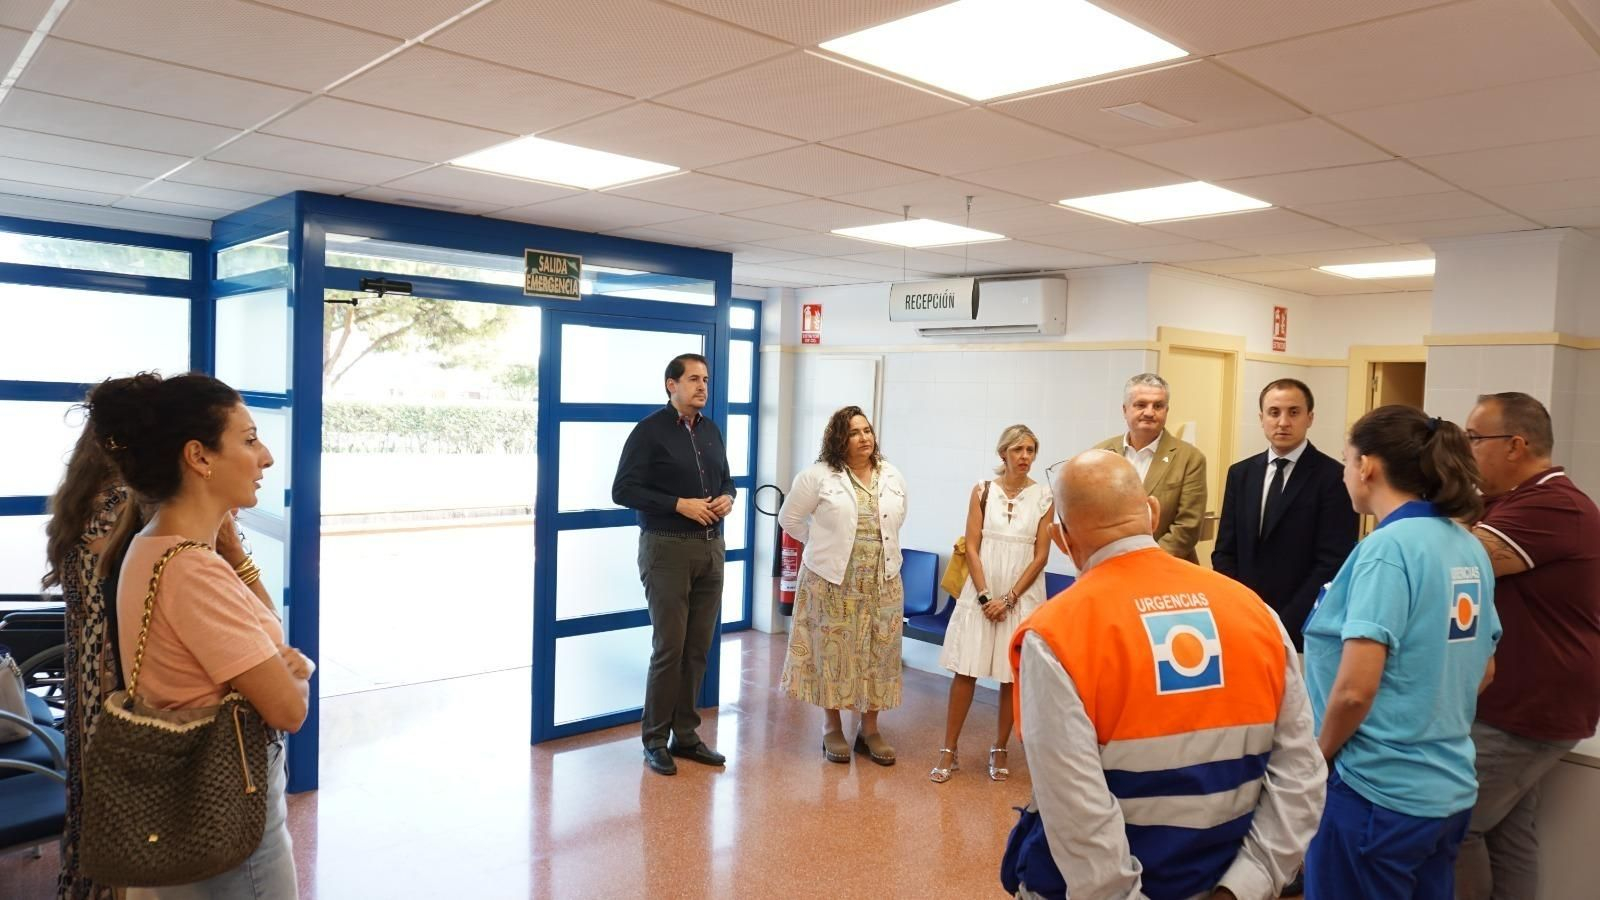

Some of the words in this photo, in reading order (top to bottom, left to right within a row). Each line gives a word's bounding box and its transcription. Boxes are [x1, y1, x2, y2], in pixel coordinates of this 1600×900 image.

[539, 255, 568, 275] SALIDA
[526, 274, 579, 295] EMERGENCIA
[905, 289, 955, 310] RECEPCIÓN
[1135, 592, 1209, 612] URGENCIAS
